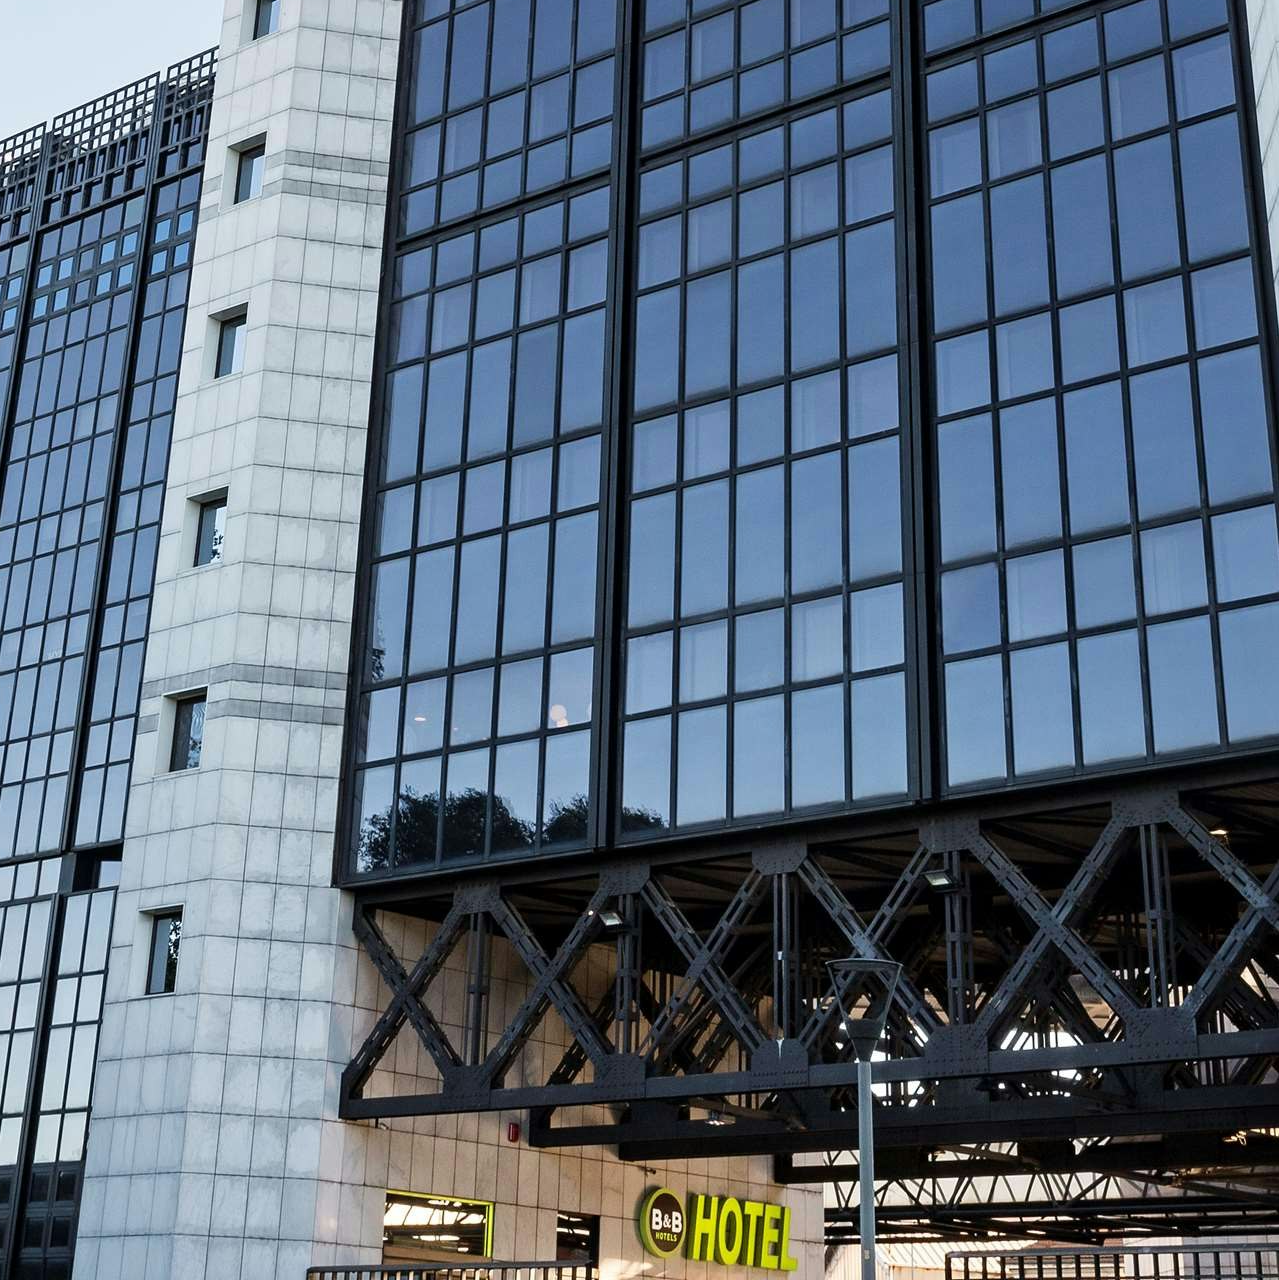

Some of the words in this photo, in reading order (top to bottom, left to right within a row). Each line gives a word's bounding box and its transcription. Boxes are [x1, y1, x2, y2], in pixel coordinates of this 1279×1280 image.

[651, 1208, 683, 1234] B&B
[690, 1194, 798, 1271] HOTEL
[655, 1231, 678, 1243] HOTELS
